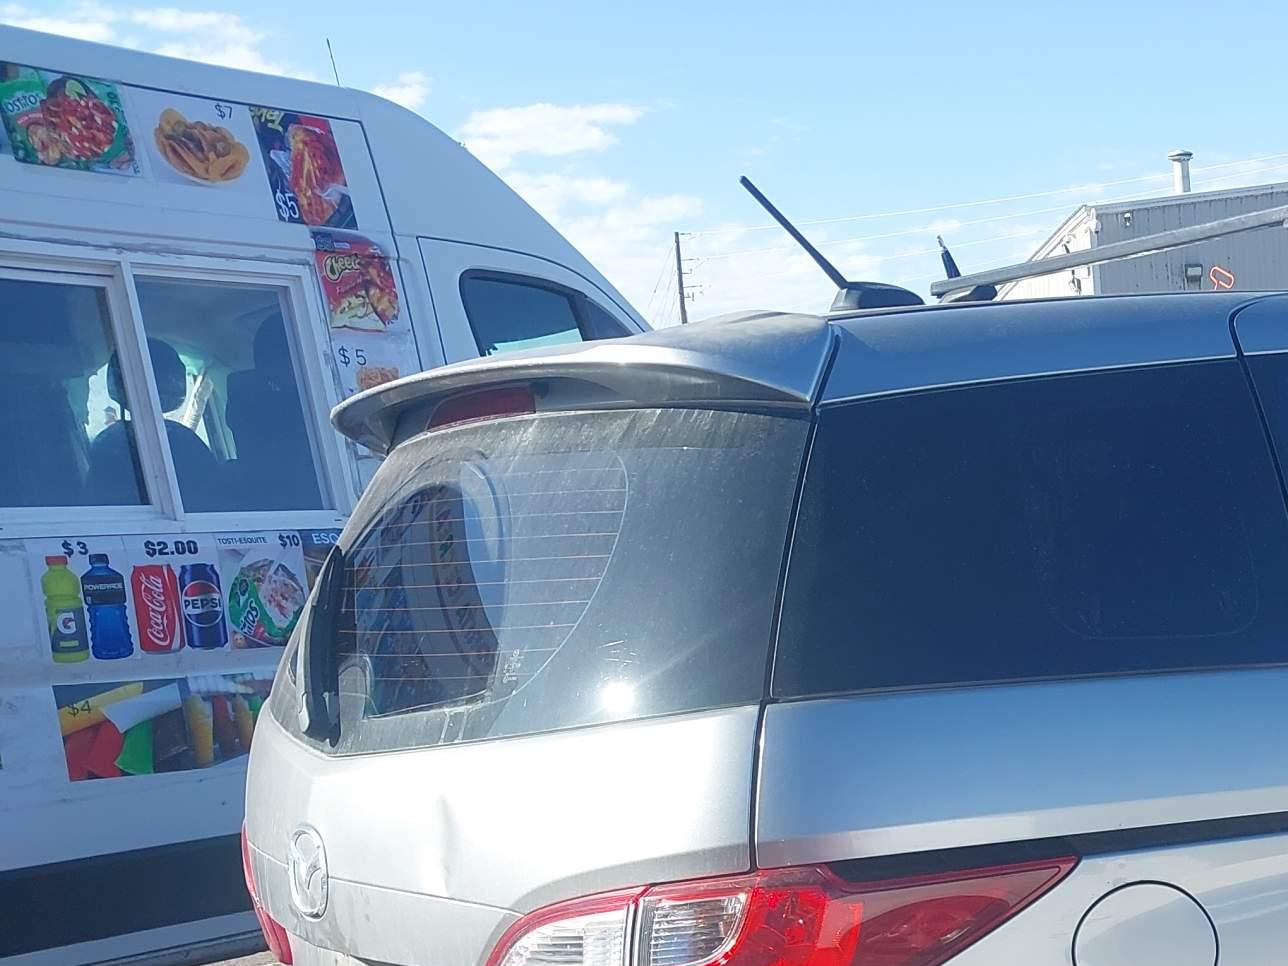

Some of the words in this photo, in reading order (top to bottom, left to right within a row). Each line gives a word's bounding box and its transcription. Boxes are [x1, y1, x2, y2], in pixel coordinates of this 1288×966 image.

[215, 103, 232, 120] $7
[275, 189, 299, 222] $5
[144, 540, 198, 558] $2.00
[278, 534, 300, 548] $10
[184, 598, 221, 610] PEPSI
[67, 700, 92, 717] $4
